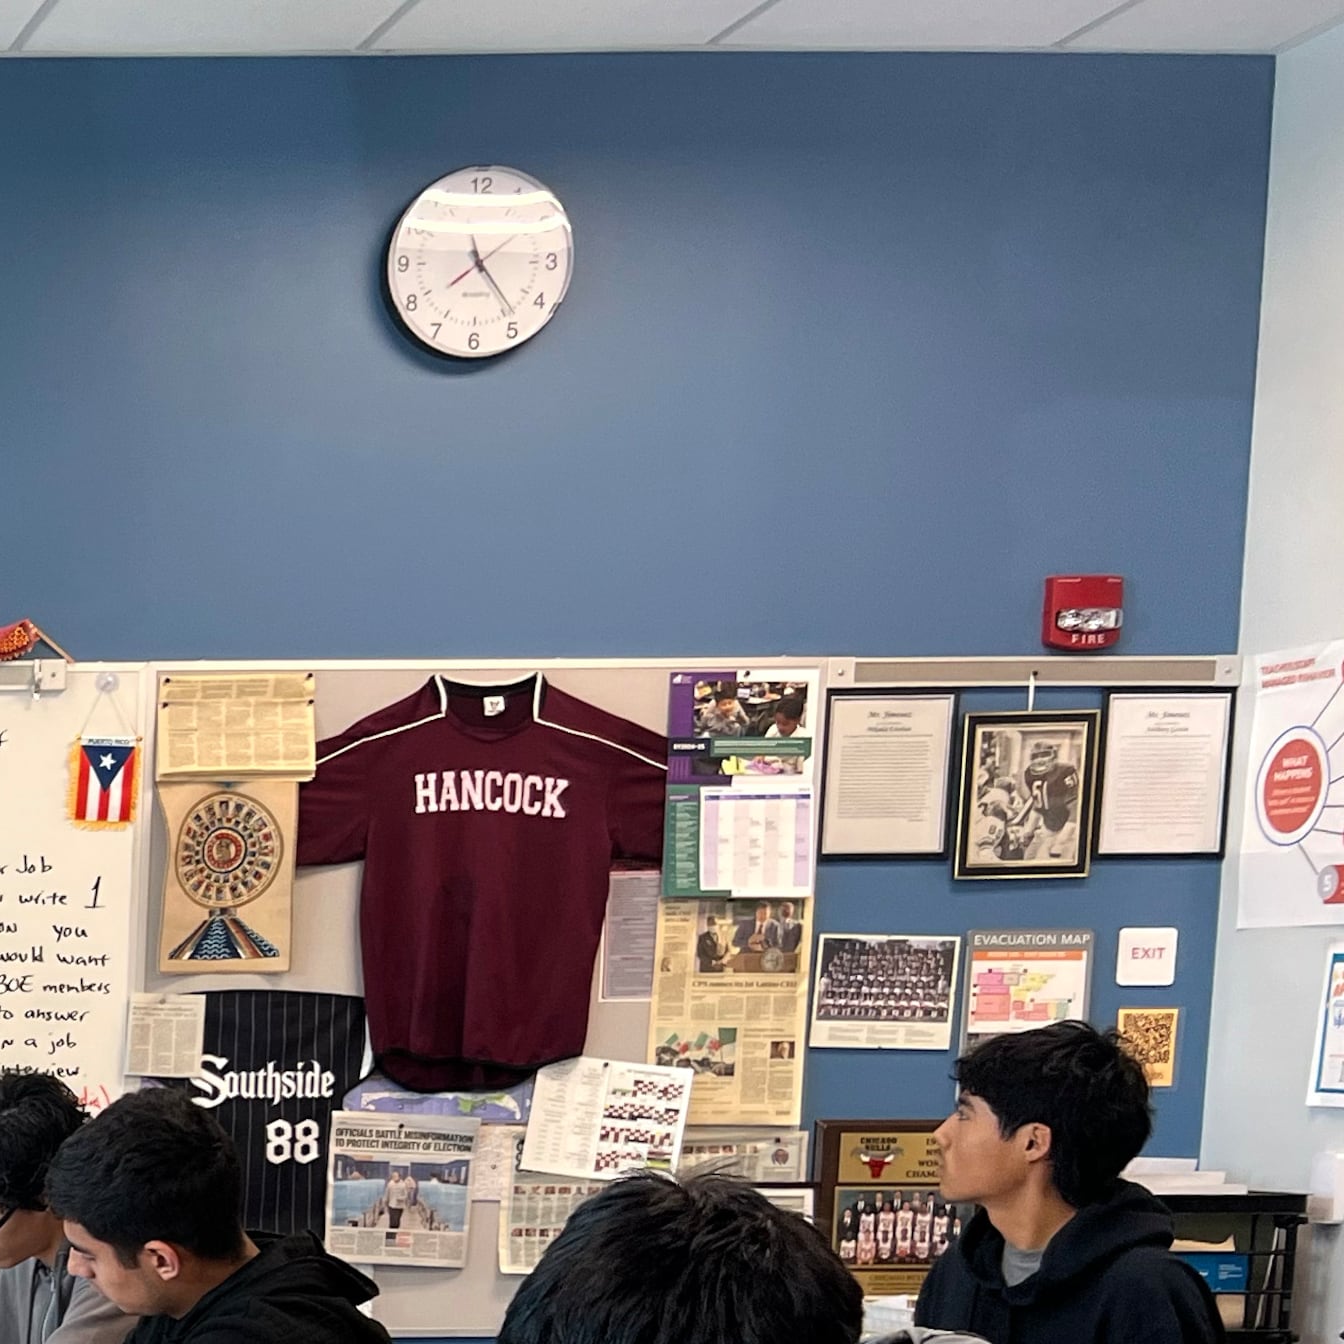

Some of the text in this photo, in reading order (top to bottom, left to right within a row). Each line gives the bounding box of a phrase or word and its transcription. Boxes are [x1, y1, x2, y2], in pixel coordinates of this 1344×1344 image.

[471, 178, 492, 194] 12
[398, 255, 409, 272] 9
[546, 254, 557, 270] 3
[406, 295, 418, 311] 8
[534, 293, 545, 308] 4
[430, 323, 442, 339] 7
[507, 322, 518, 338] 5
[468, 333, 480, 350] 6
[1072, 633, 1106, 645] FIRE
[414, 770, 570, 818] HANCOCK
[16, 856, 53, 875] Job
[18, 890, 68, 907] write
[84, 876, 106, 909] 1
[53, 924, 89, 943] you
[974, 934, 1091, 946] EVACUATION MAP
[56, 952, 112, 968] want
[1131, 947, 1166, 960] EXIT
[42, 978, 112, 996] members
[24, 1008, 91, 1022] answer
[24, 1037, 39, 1049] a
[50, 1033, 79, 1055] job
[190, 1053, 336, 1109] Southside
[265, 1118, 320, 1165] 88
[335, 1128, 374, 1138] OFFICIALS
[375, 1129, 402, 1140] BATTLE
[335, 1138, 345, 1148] TO
[346, 1139, 380, 1149] PROTECT
[422, 1142, 432, 1151] OF
